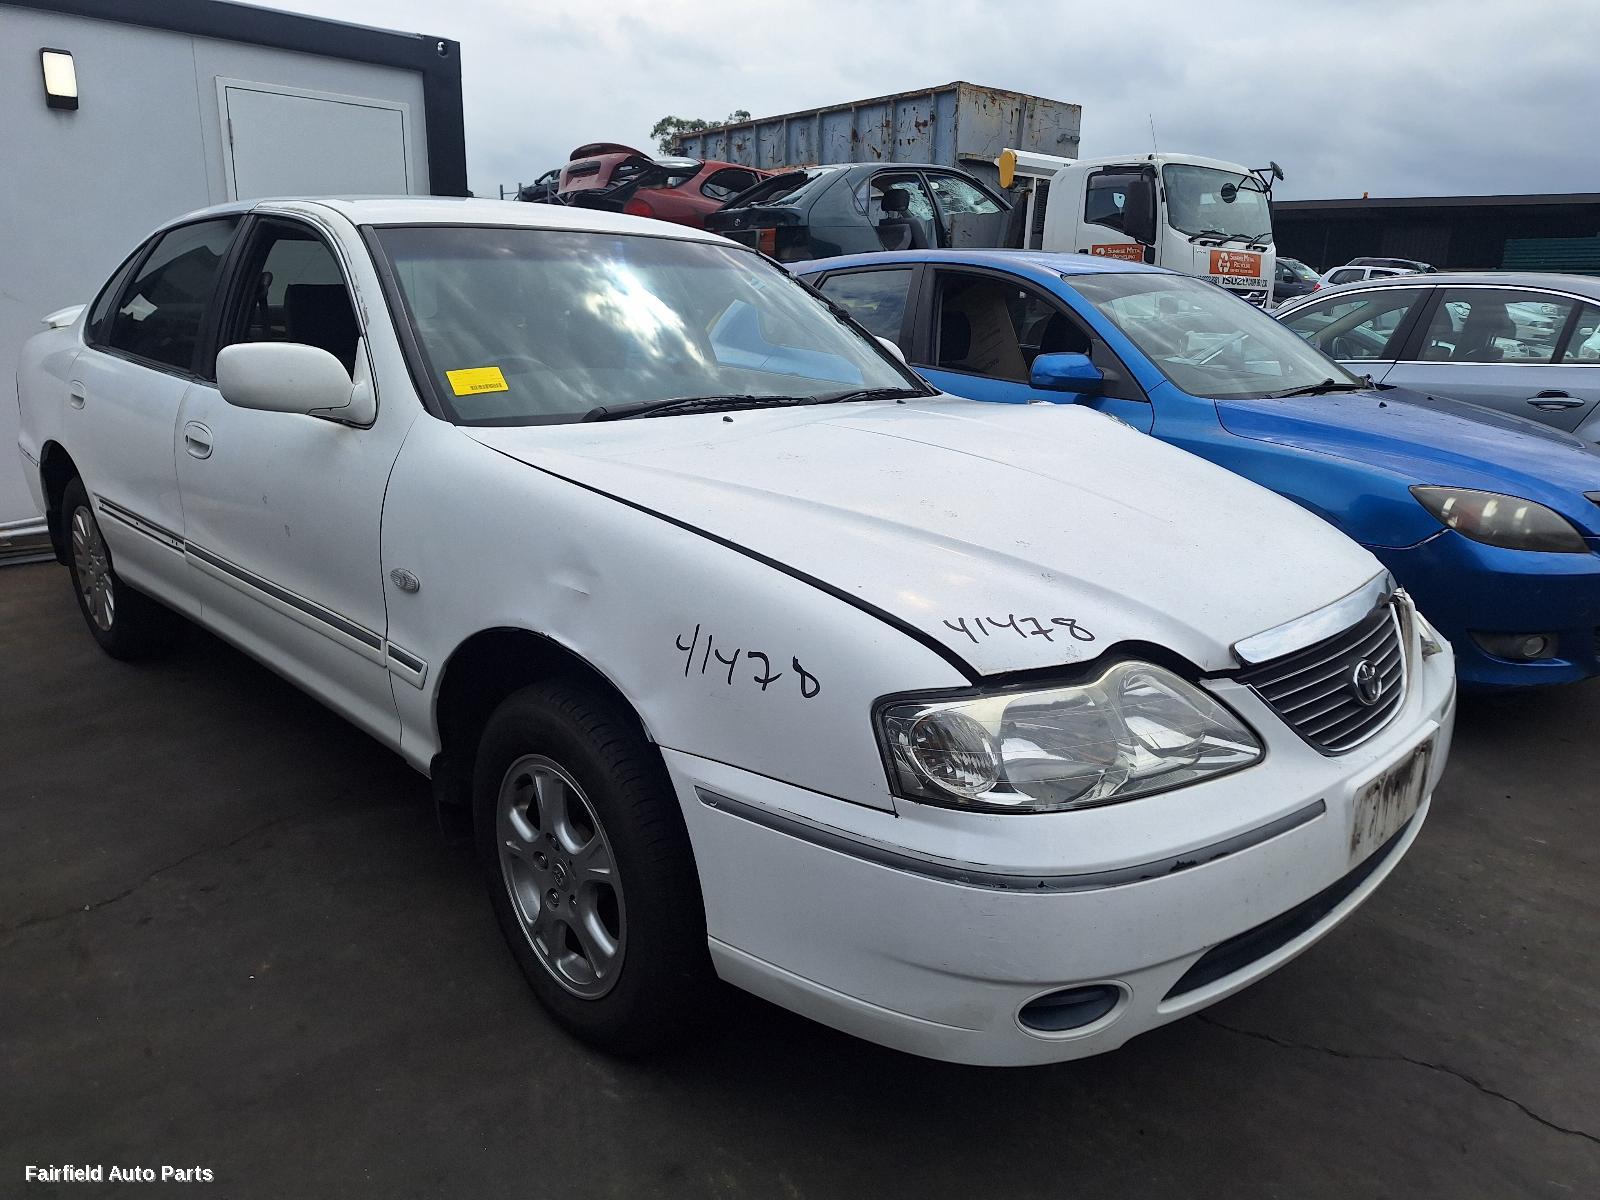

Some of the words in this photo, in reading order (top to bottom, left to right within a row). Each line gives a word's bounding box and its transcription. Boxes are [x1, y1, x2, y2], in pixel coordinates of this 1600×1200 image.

[1222, 276, 1248, 286] ISUZU
[943, 614, 1095, 643] 41478
[676, 624, 820, 698] 41478
